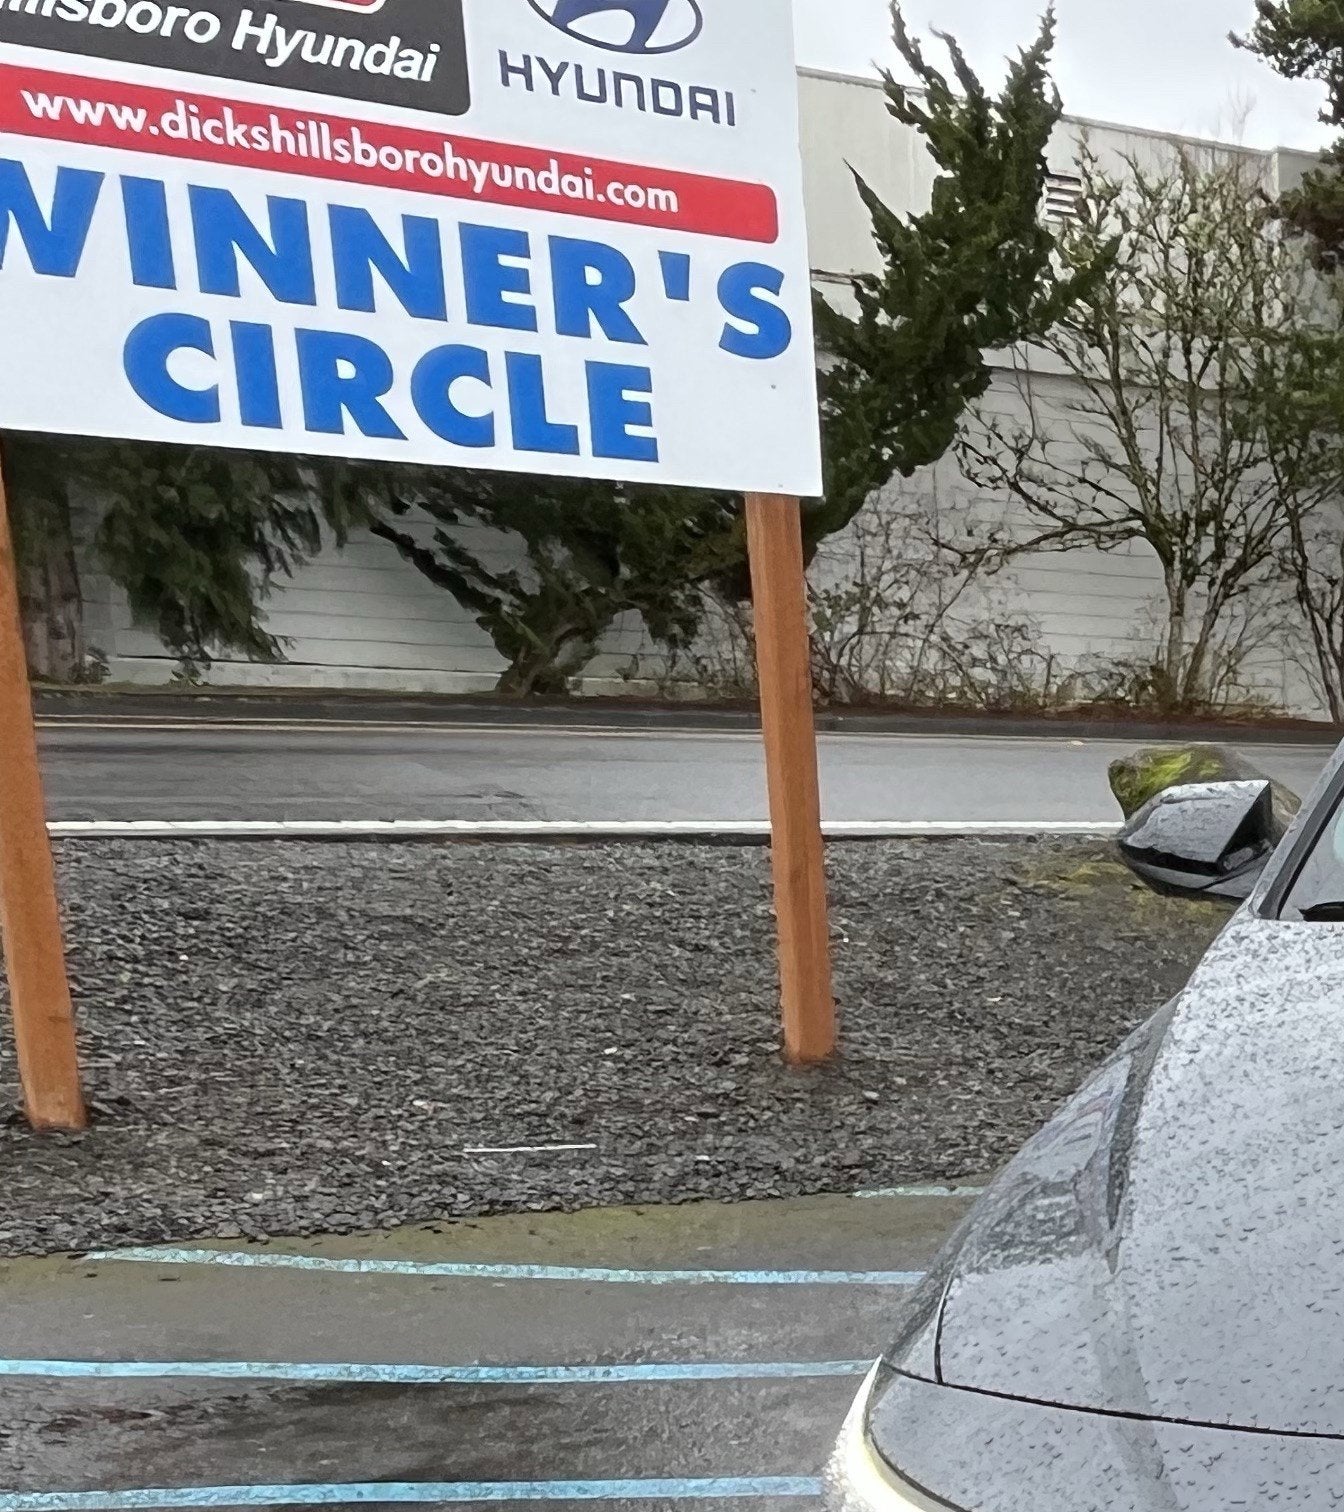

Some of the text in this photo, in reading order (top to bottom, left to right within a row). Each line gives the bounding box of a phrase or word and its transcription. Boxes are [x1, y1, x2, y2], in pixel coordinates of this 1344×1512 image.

[231, 8, 442, 82] Hyundai
[498, 49, 737, 127] HYUNDAI
[21, 89, 679, 213] www.dickshillsborohyundai.com
[0, 157, 792, 359] WINNER'S
[123, 312, 659, 463] CIRCLE
